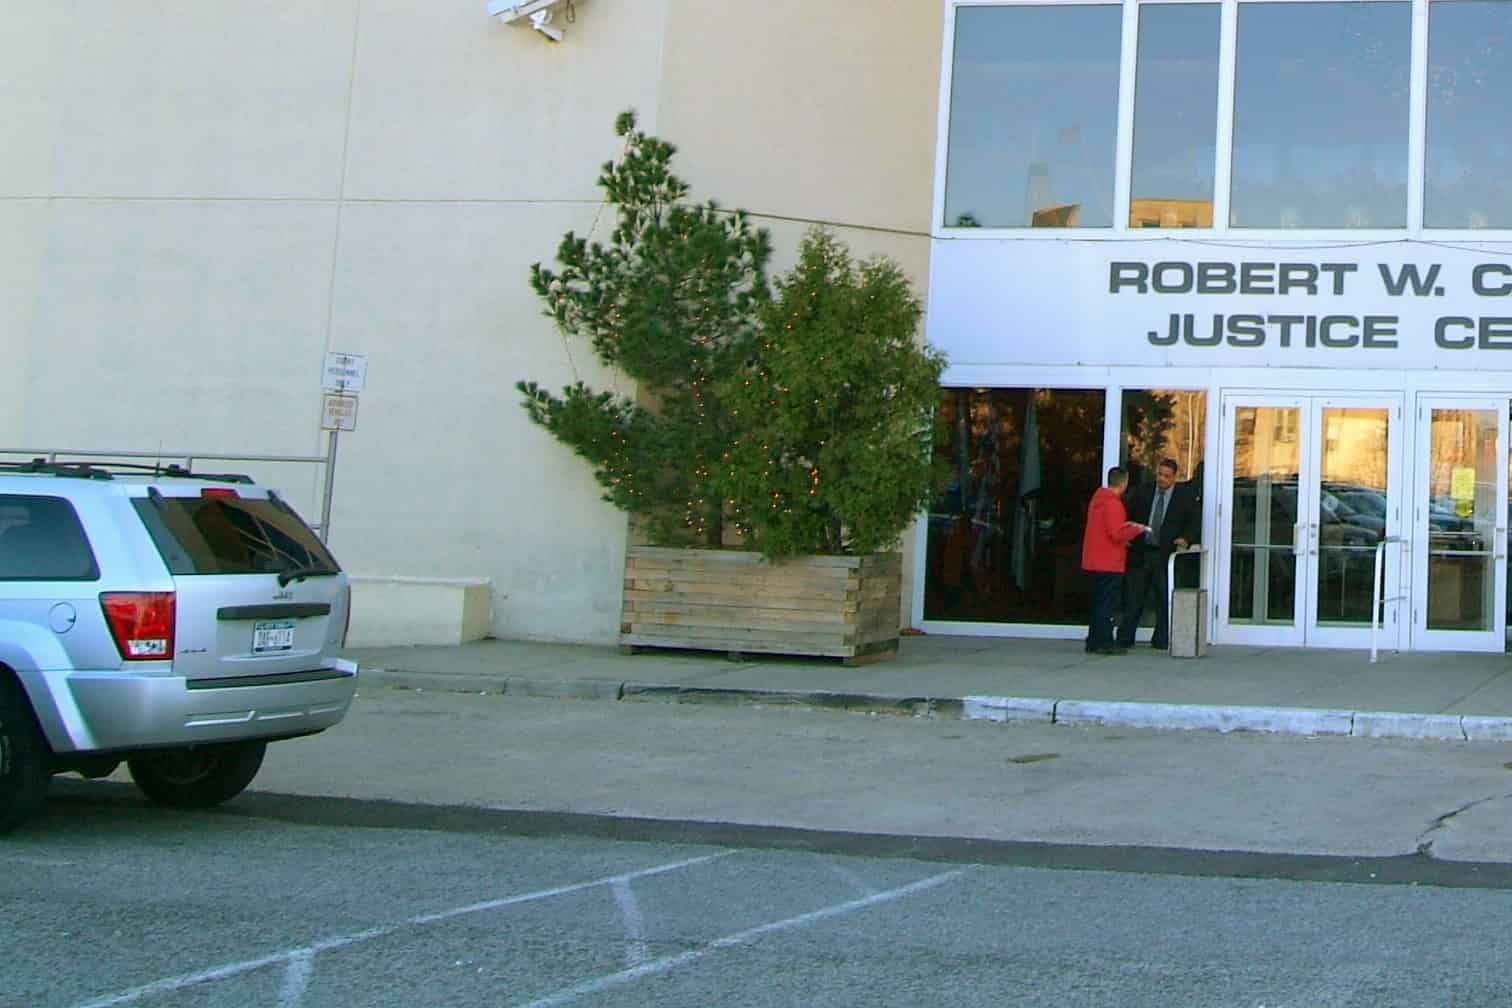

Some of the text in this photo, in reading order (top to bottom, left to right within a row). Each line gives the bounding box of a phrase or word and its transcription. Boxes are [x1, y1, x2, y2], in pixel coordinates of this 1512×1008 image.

[1109, 261, 1358, 296] ROBERT
[1377, 263, 1445, 297] W.
[1147, 313, 1399, 348] JUSTICE
